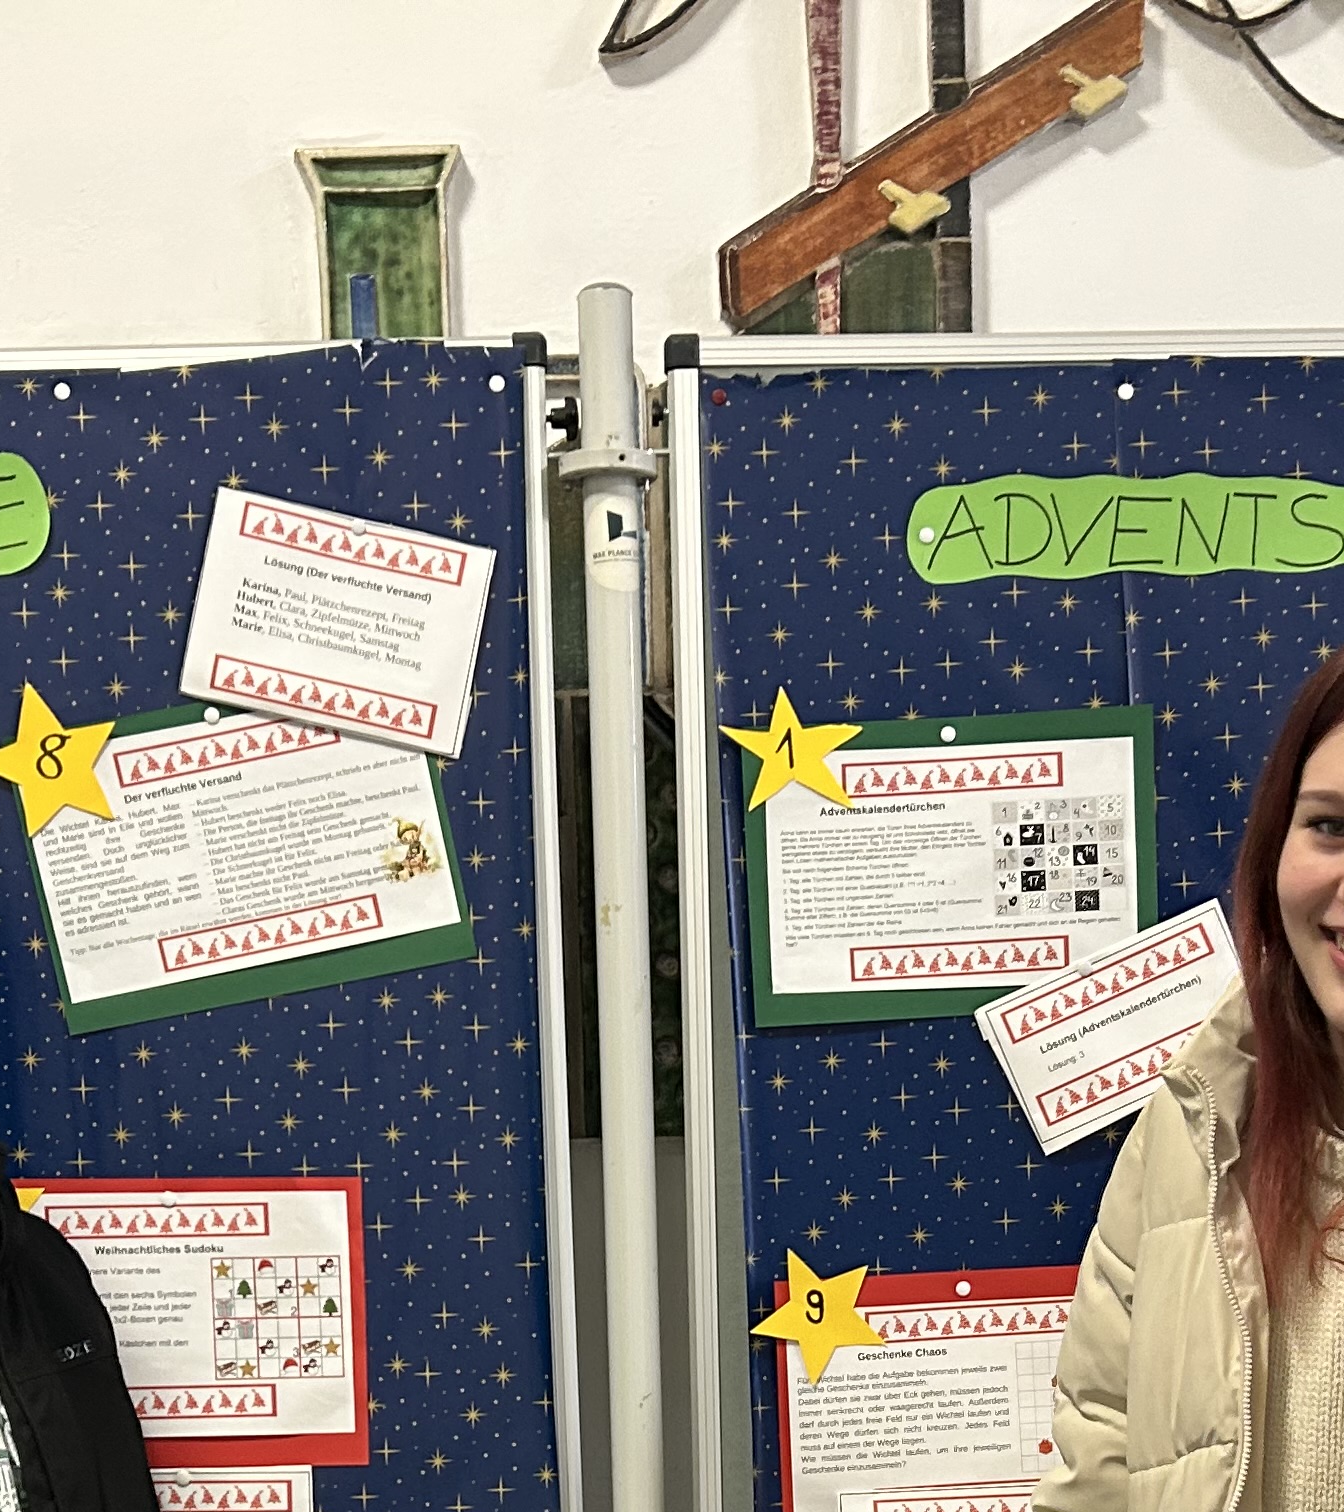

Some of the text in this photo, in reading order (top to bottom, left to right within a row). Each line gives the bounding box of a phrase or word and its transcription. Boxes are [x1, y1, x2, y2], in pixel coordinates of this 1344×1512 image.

[35, 733, 72, 779] 8
[775, 726, 795, 769] 1
[123, 771, 242, 804] Der verfluchte Versand
[819, 803, 946, 816] Adventskalendertürchen
[1002, 800, 1114, 818] 1 2 3 4 5
[995, 823, 1117, 843] 6 7 8 9 10
[996, 846, 1119, 869] 11 12 13 14 15
[1007, 870, 1123, 887] 16 17 18 19 20
[997, 904, 1008, 915] 21
[1028, 898, 1041, 909] 22
[1059, 892, 1072, 902] 23
[1039, 976, 1202, 1054] Lösung (Adventskalendertürchen)
[1078, 1050, 1085, 1059] 3
[805, 1289, 824, 1324] 9
